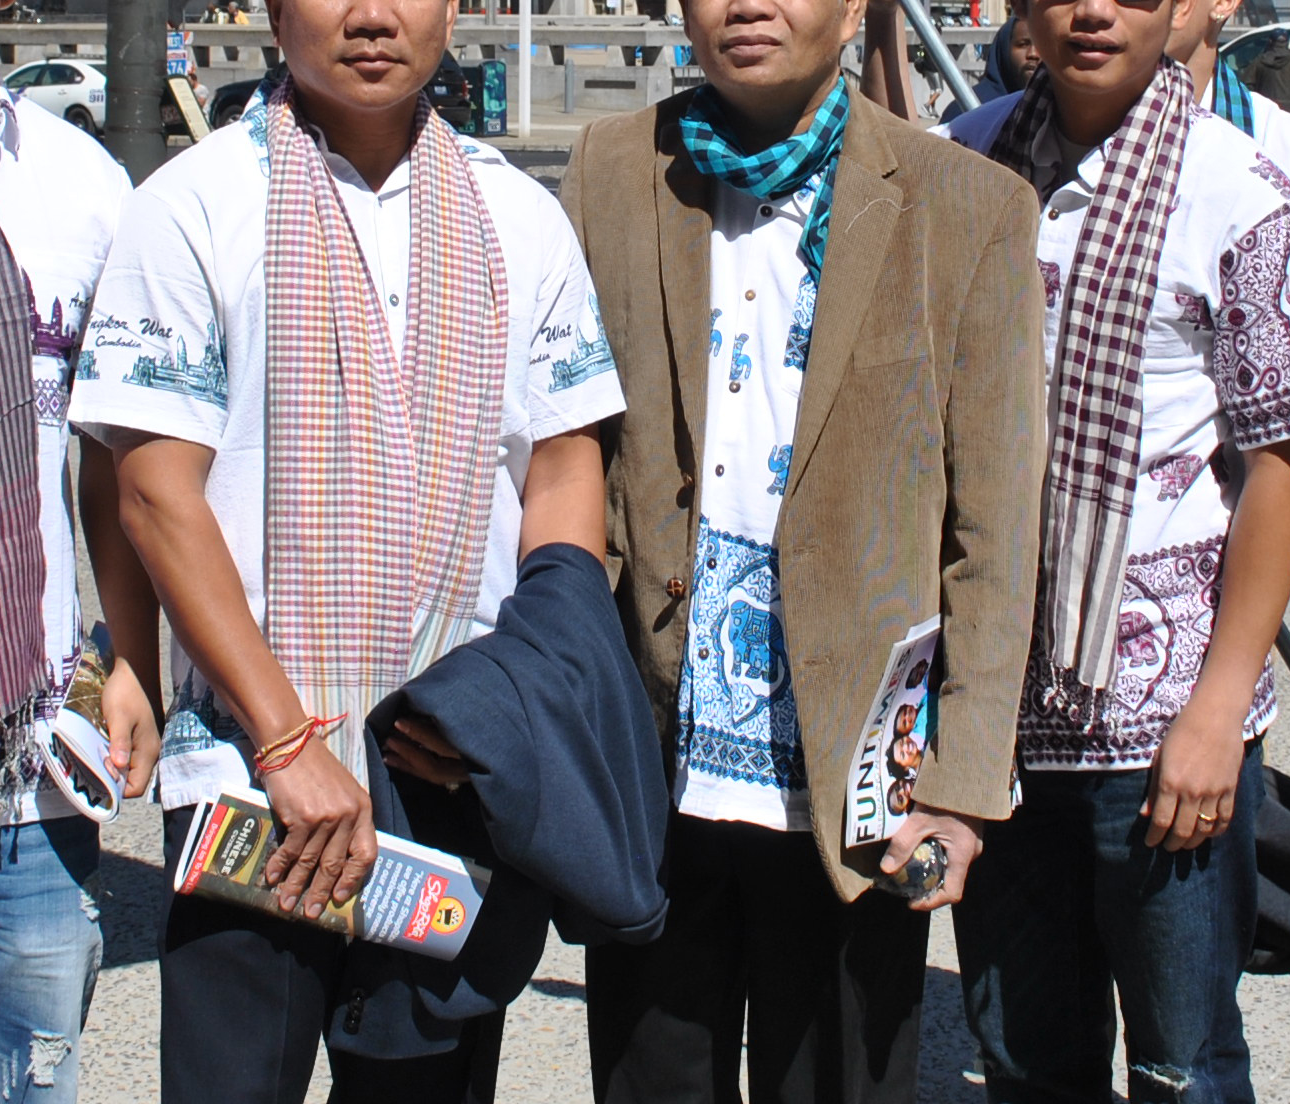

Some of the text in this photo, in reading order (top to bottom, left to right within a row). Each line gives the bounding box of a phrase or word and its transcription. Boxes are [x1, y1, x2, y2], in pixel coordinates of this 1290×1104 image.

[89, 314, 173, 339] ngkor Wat
[540, 323, 573, 343] Wat
[95, 335, 142, 349] Cambodia
[221, 818, 255, 876] CHINESE
[367, 858, 395, 918] to our diverse
[395, 879, 409, 901] offer
[405, 894, 412, 905] at
